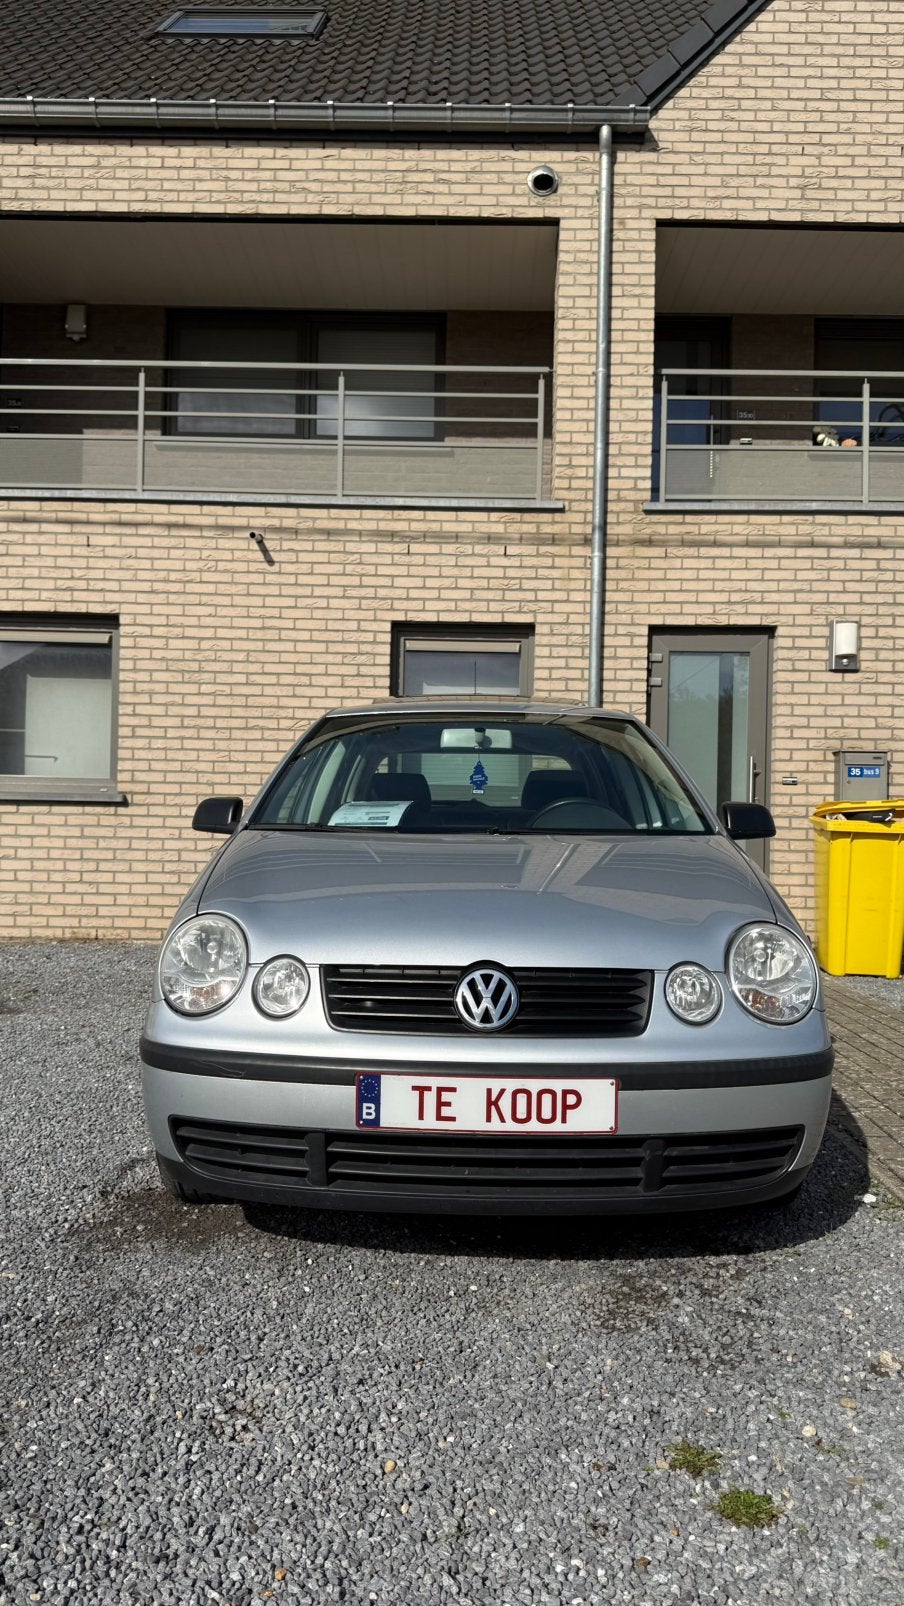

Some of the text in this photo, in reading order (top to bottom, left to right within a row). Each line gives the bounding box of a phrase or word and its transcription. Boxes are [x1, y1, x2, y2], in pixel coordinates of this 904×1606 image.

[850, 768, 861, 776] 35
[362, 1103, 376, 1120] B
[411, 1085, 583, 1125] TE KOOP
